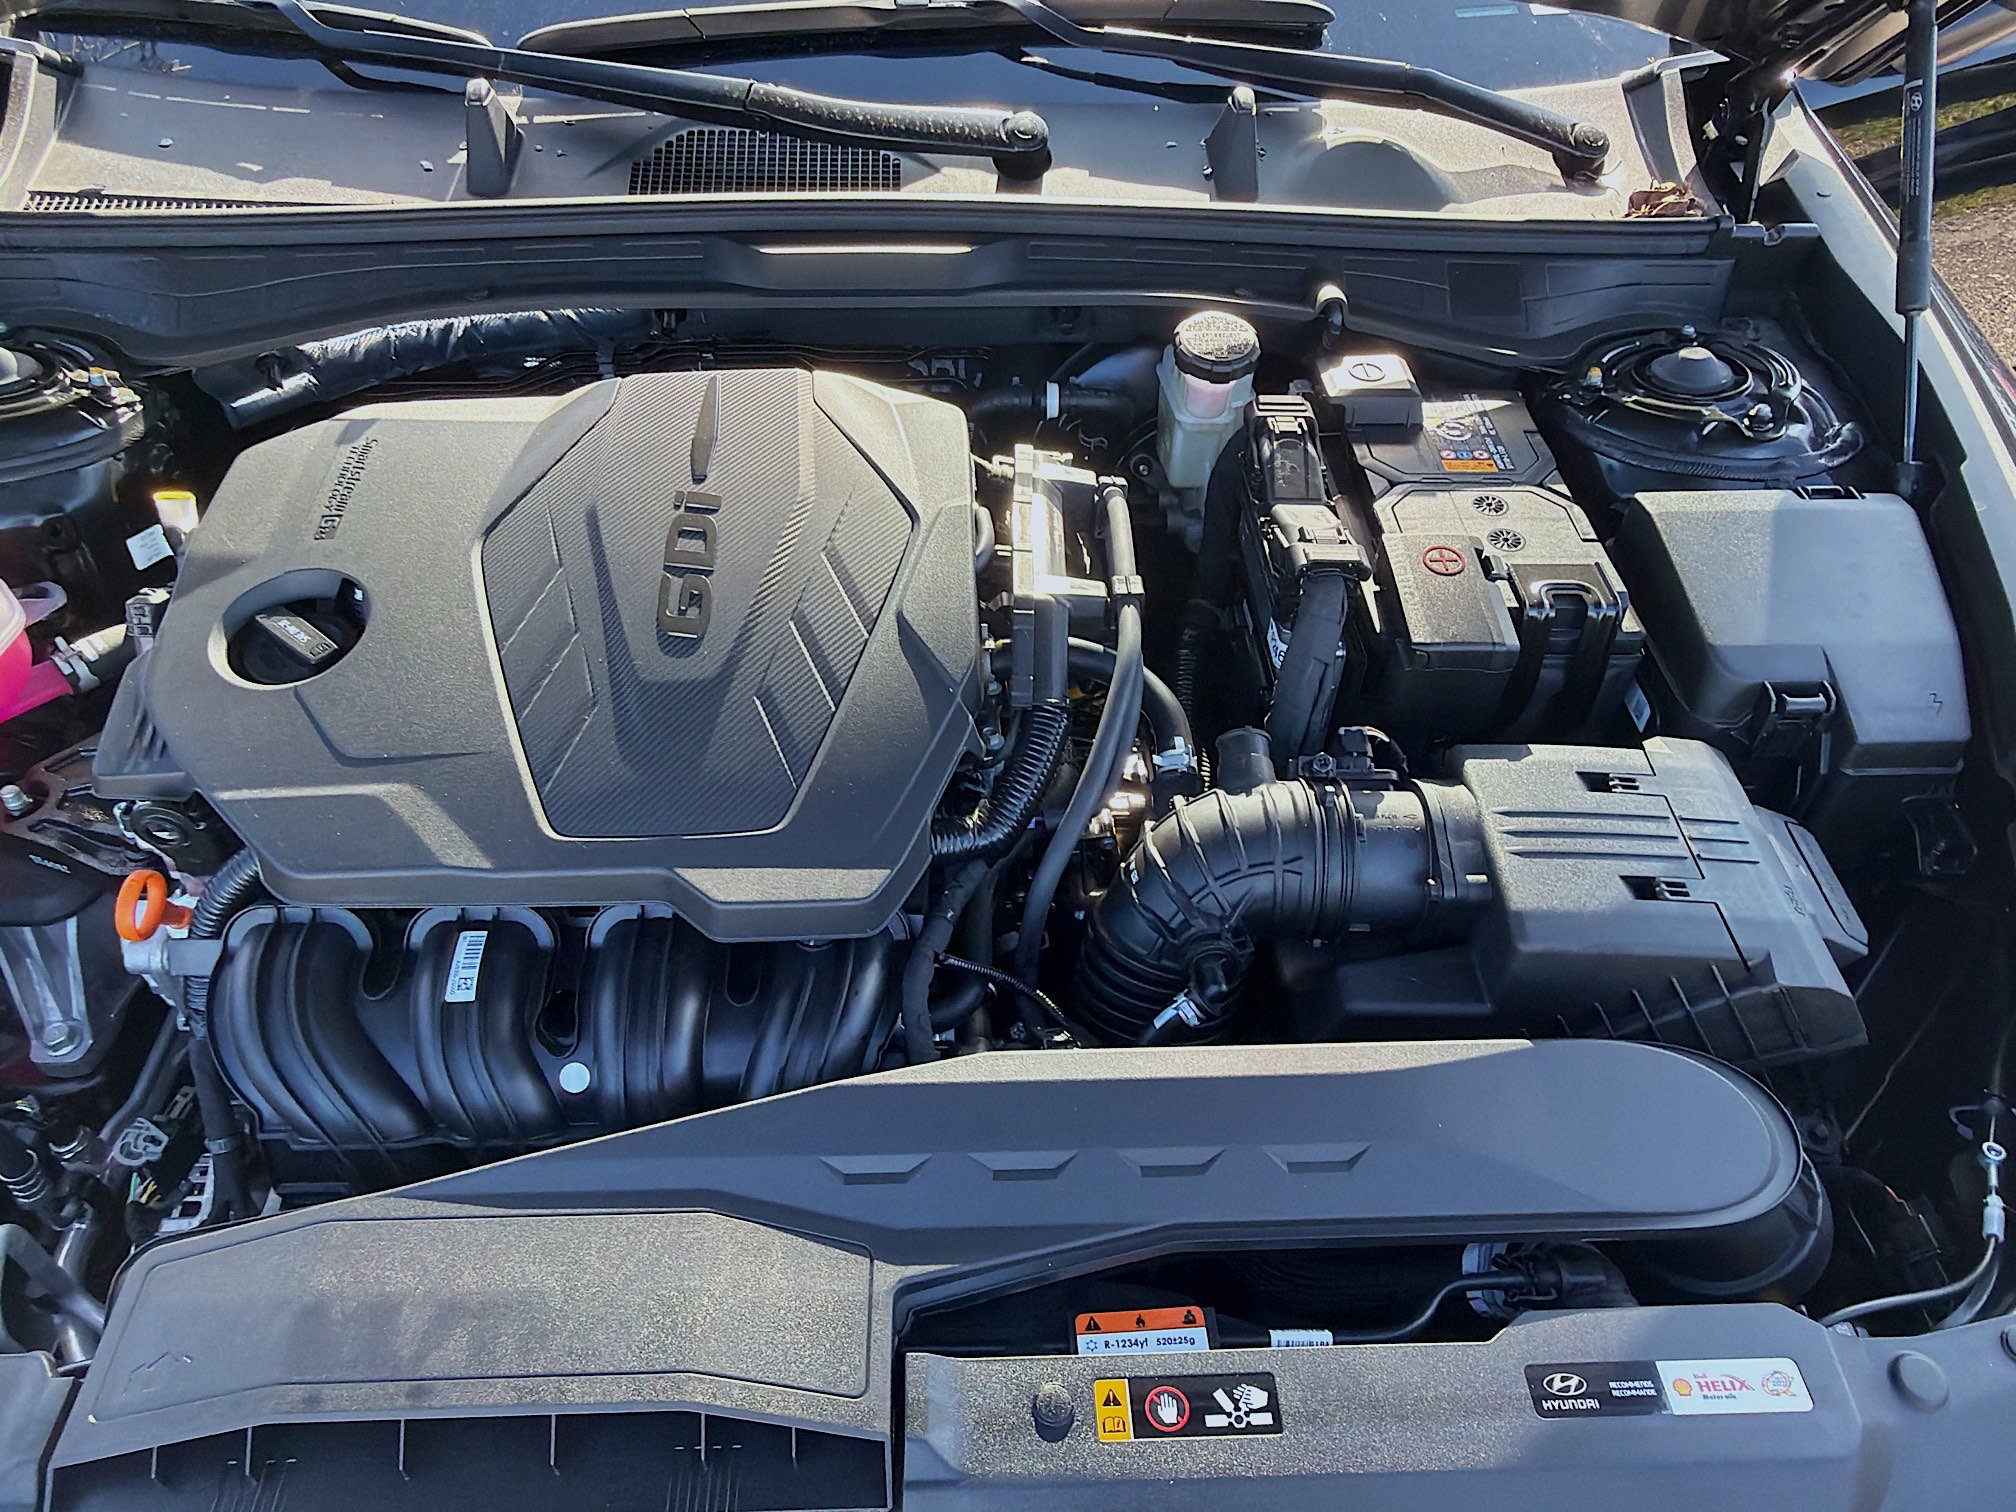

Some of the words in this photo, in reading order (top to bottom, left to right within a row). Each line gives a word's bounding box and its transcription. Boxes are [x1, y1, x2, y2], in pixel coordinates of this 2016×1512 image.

[335, 437, 378, 513] Smartstream
[657, 490, 723, 638] GDi
[1104, 1337, 1149, 1349] R-1234yf
[1156, 1336, 1196, 1347] 520±25g
[1695, 1379, 1754, 1393] HELIX
[1541, 1398, 1601, 1411] HYUNDAI
